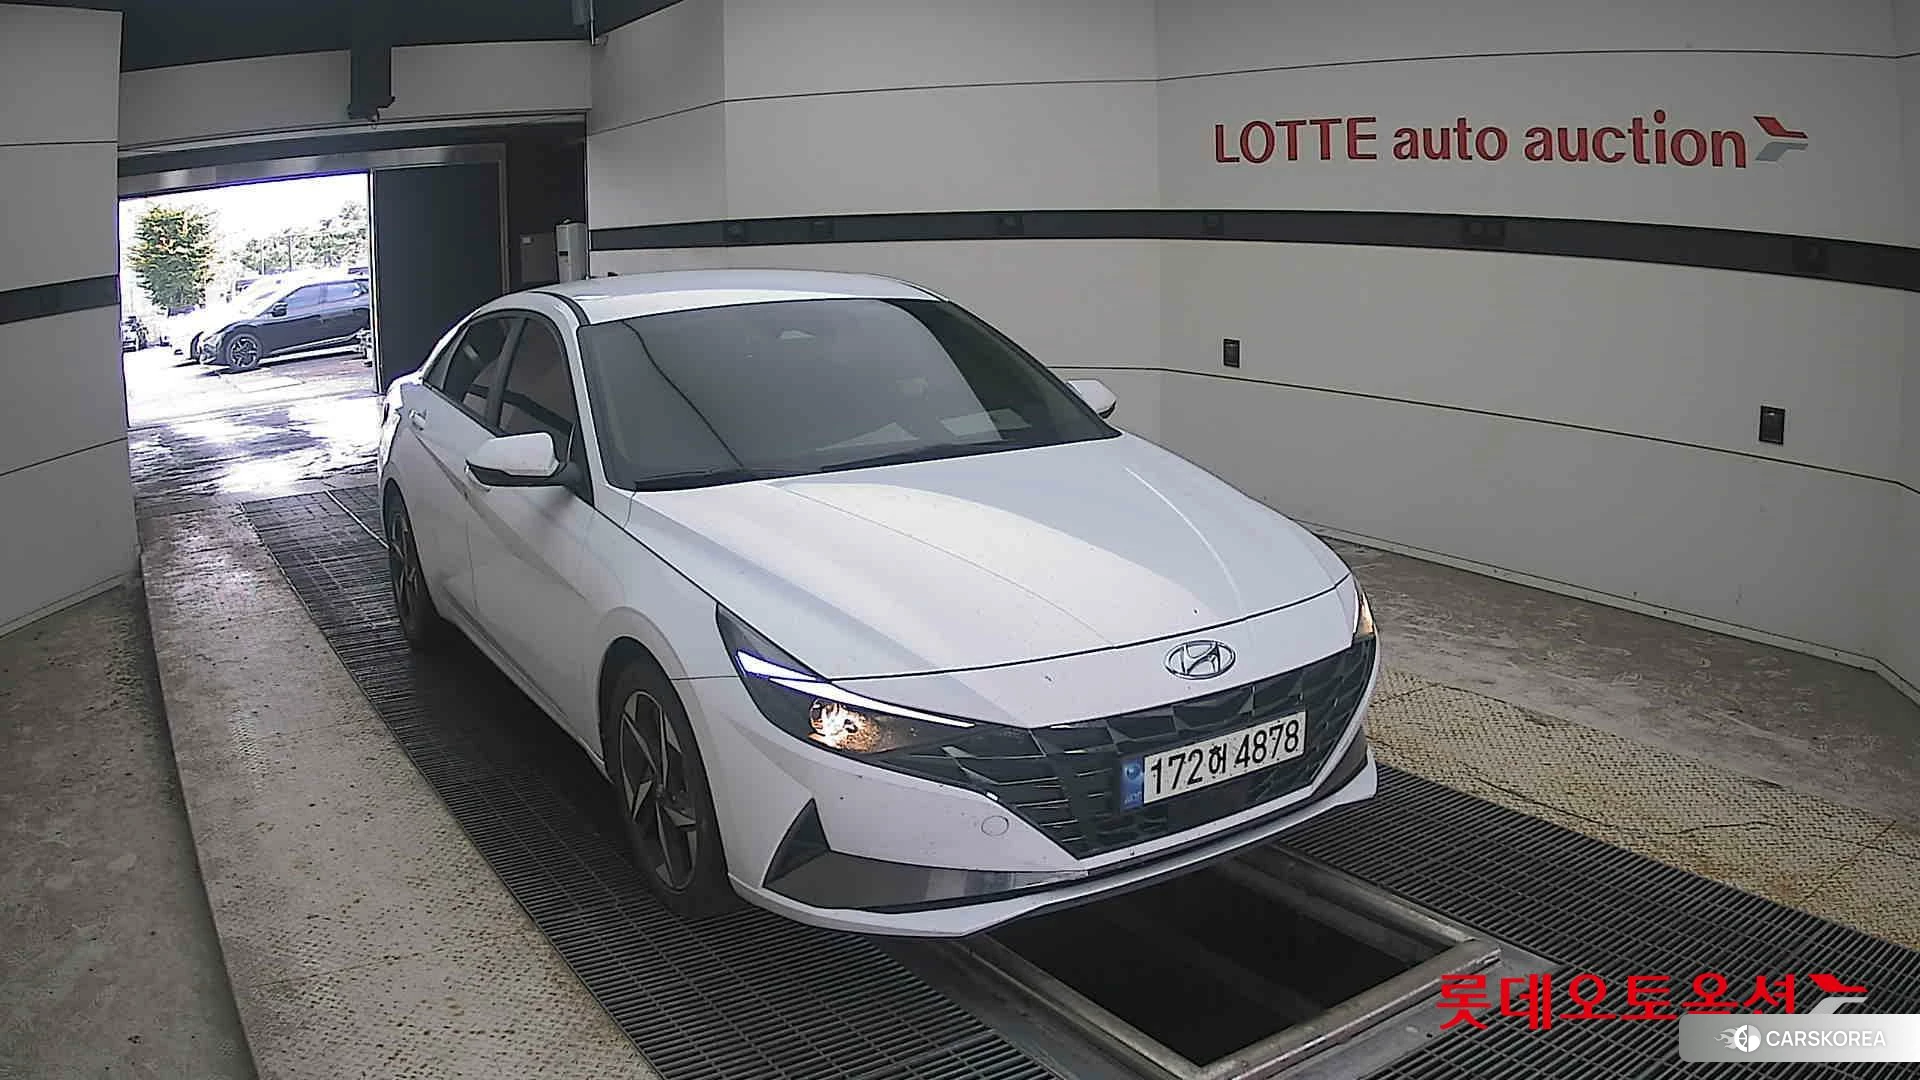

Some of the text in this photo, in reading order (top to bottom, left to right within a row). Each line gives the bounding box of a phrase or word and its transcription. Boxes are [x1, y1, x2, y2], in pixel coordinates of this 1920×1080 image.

[1214, 110, 1747, 168] LOTTE auto auction
[1150, 719, 1300, 795] 172허 4878
